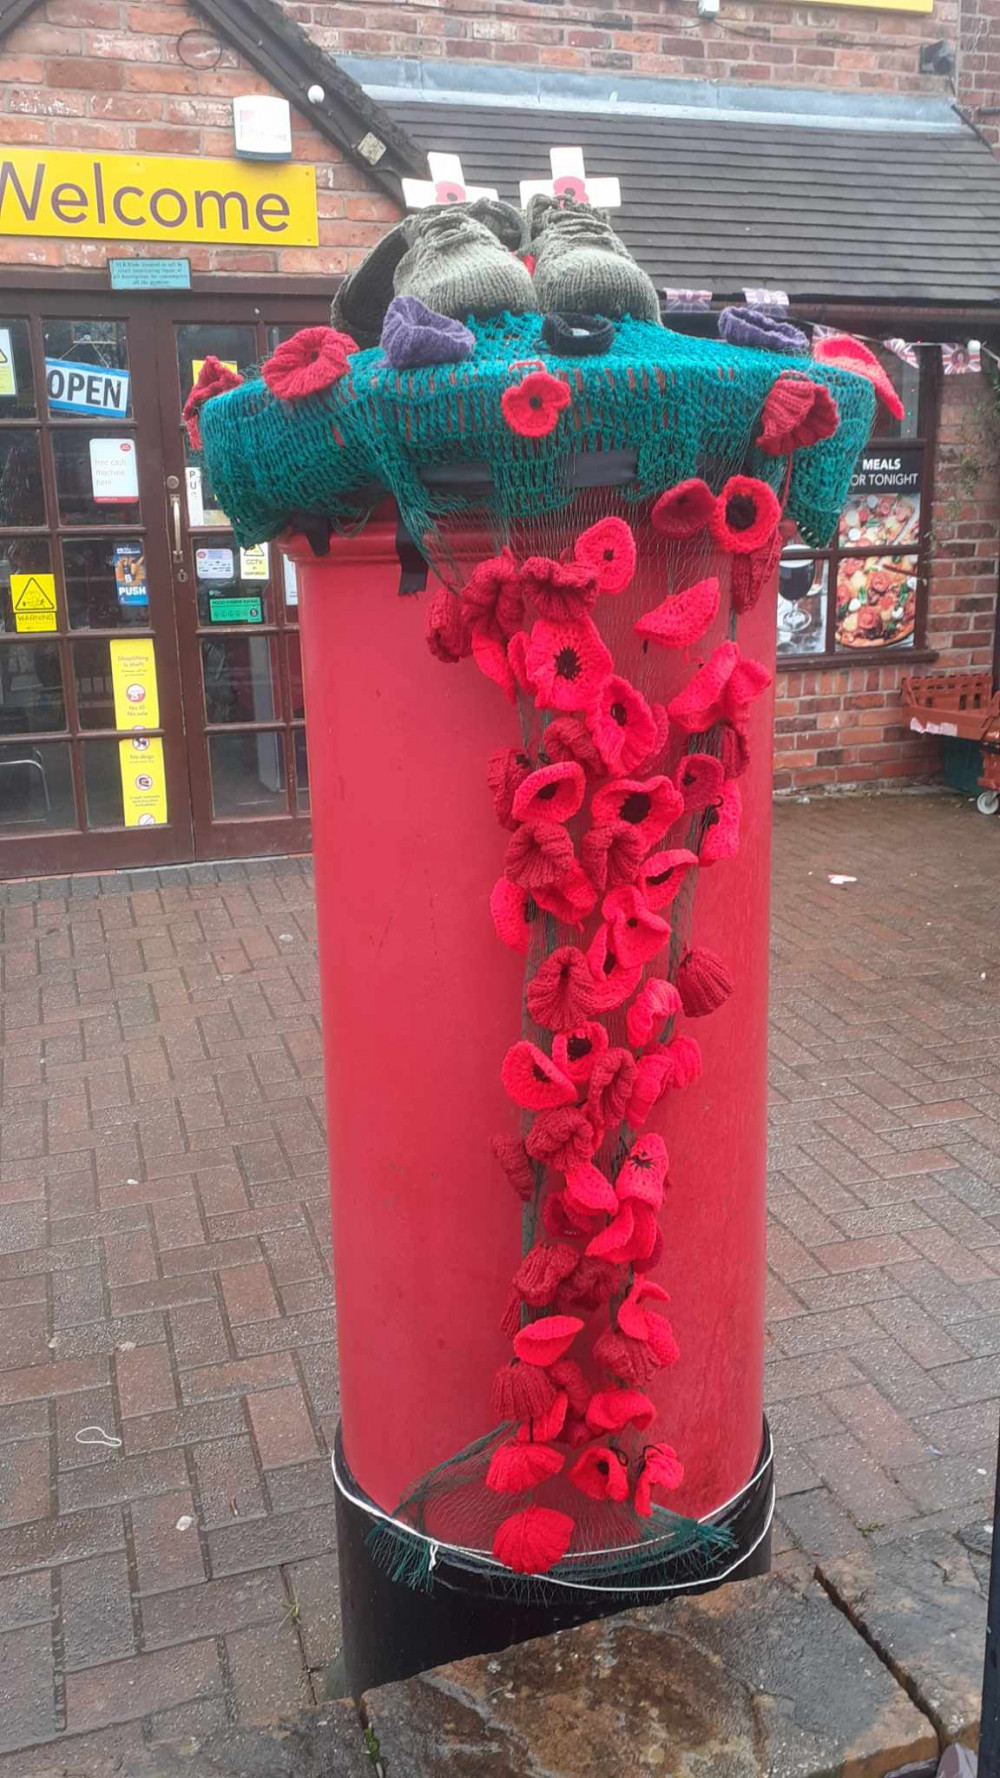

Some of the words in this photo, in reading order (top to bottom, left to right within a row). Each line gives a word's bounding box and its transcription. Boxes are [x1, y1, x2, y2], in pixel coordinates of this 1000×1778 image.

[0, 161, 290, 232] Welcome
[47, 369, 121, 408] OPEN
[862, 458, 901, 470] MEALS
[850, 474, 866, 486] OR
[868, 472, 918, 486] TONIGHT
[118, 586, 146, 596] PUSH
